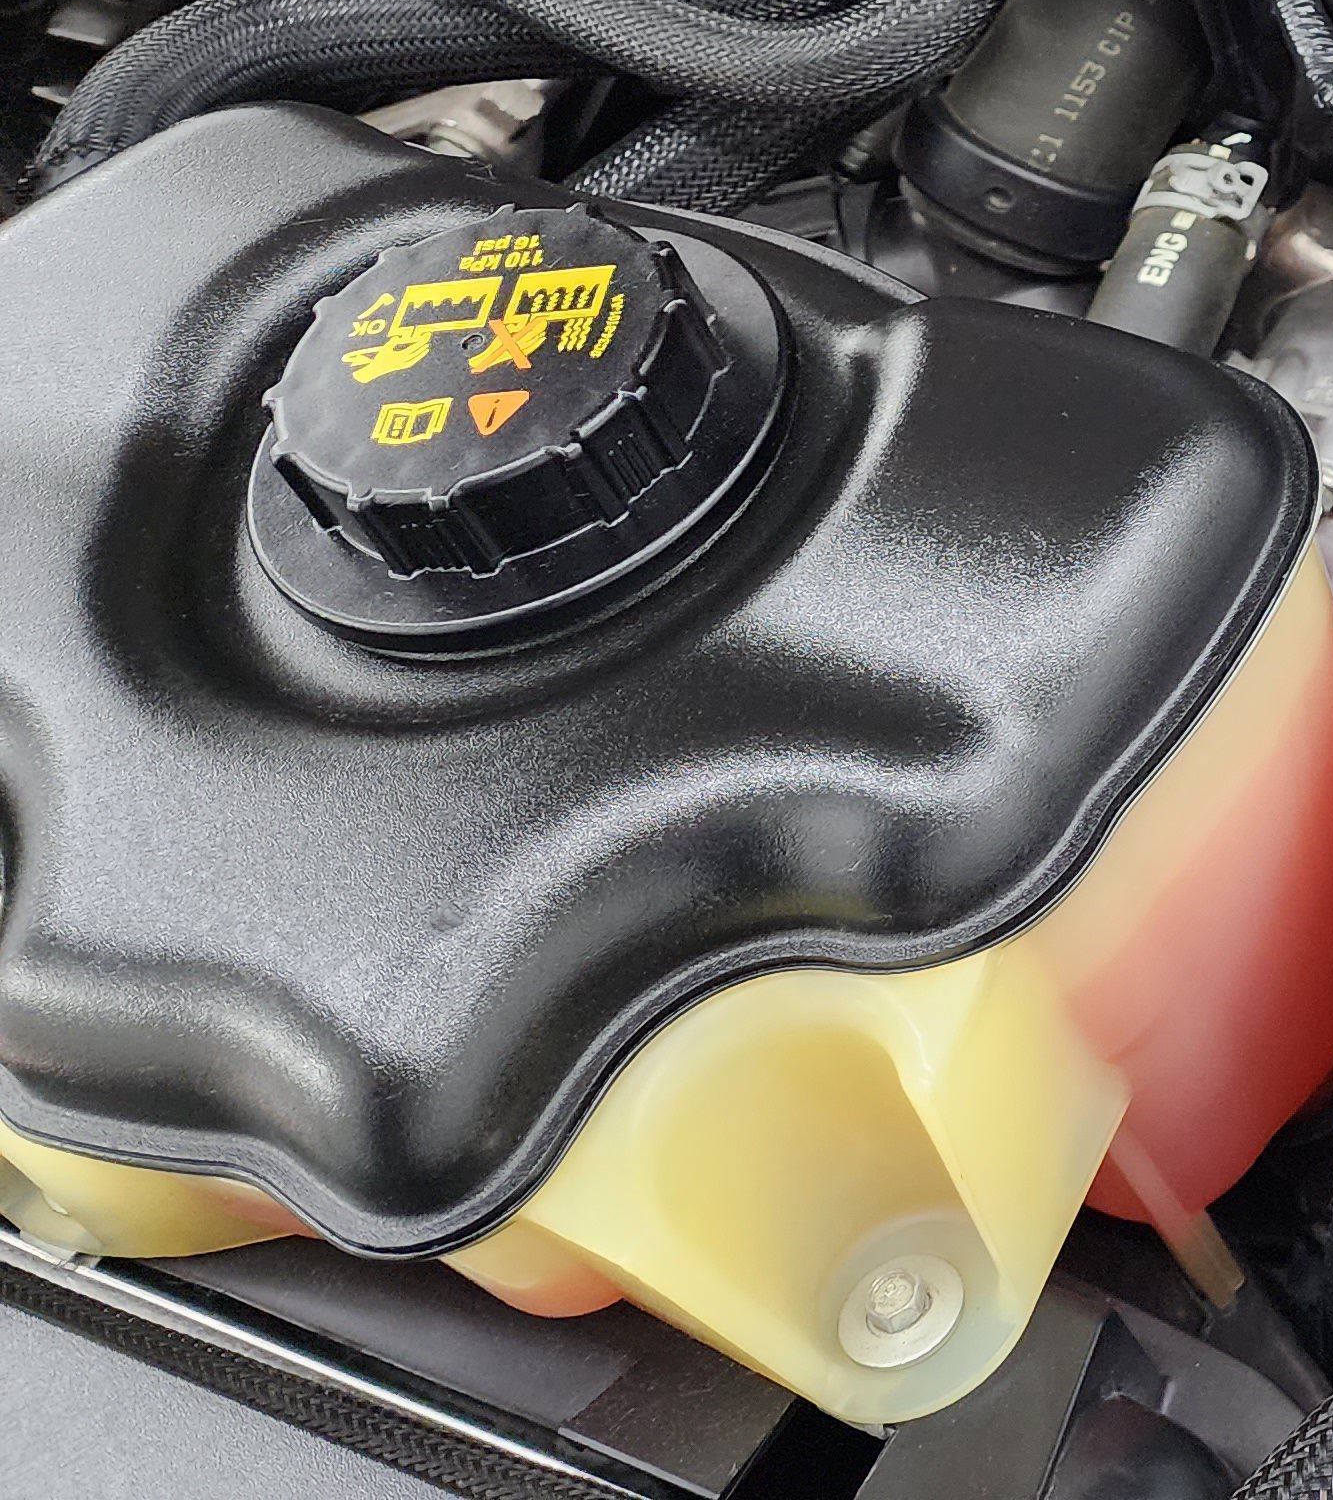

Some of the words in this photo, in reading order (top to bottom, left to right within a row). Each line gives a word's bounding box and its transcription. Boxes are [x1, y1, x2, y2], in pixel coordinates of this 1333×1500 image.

[1054, 60, 1106, 121] 1153
[472, 235, 512, 256] psi
[514, 234, 540, 251] 16
[458, 251, 502, 273] kPa
[505, 249, 544, 268] 110
[1136, 232, 1188, 287] ENG
[349, 318, 386, 338] OK
